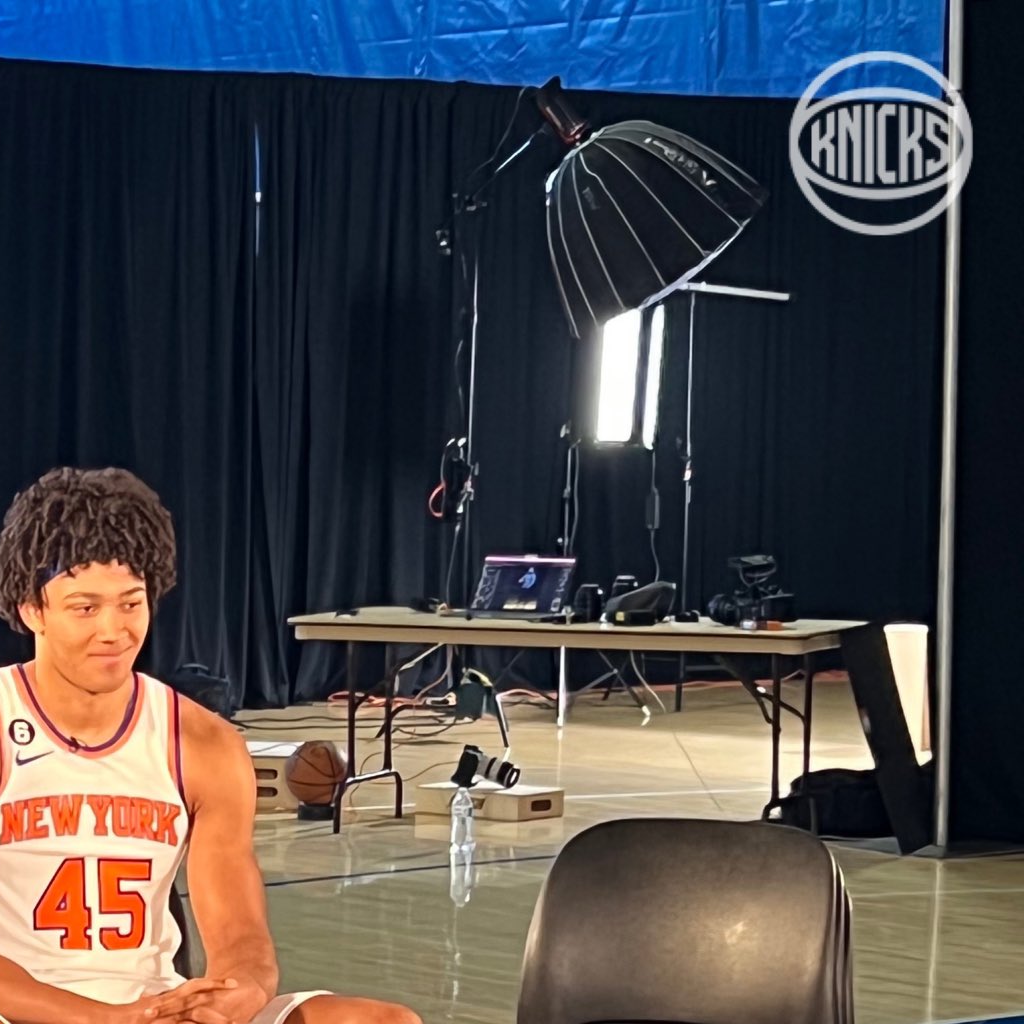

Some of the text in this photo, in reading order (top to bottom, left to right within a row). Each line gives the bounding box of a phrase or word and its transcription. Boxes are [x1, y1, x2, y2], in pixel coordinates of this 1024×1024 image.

[0, 794, 181, 847] NEW YORK
[33, 856, 152, 950] 45
